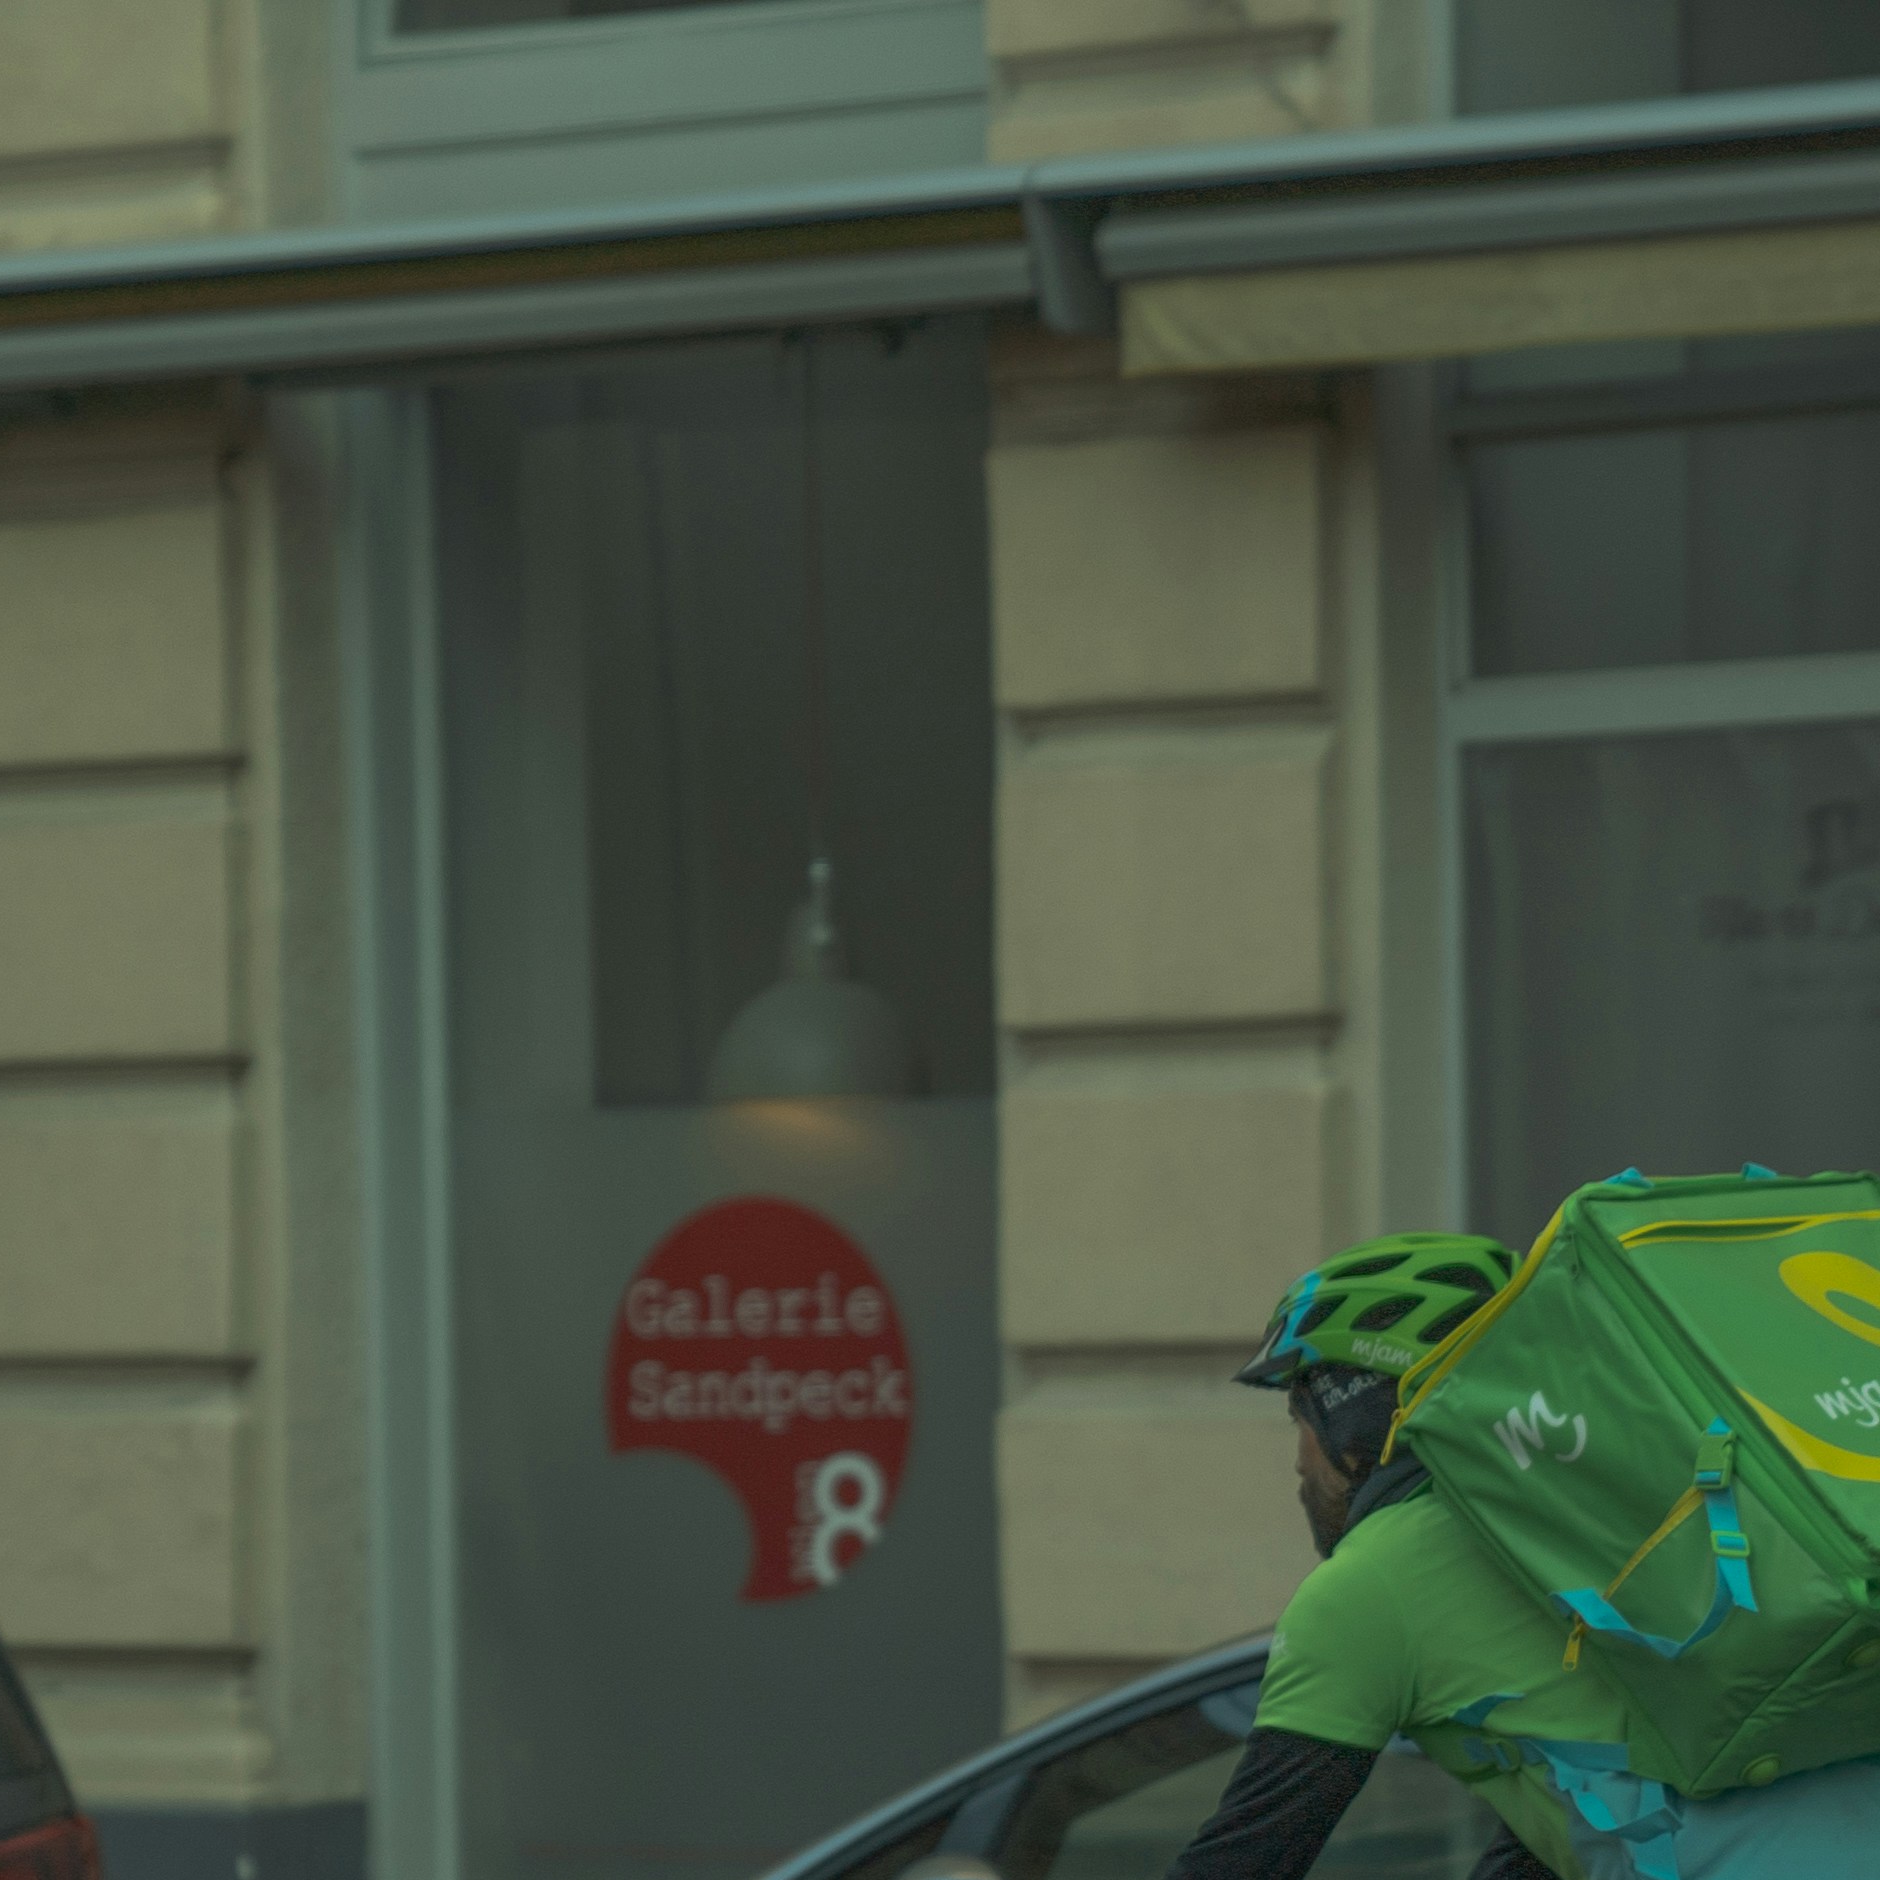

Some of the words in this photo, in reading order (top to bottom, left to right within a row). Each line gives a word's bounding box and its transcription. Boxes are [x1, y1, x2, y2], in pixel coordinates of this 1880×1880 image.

[625, 1273, 887, 1340] Galerie
[1351, 1336, 1413, 1367] mjam
[626, 1354, 912, 1435] Sandpeck
[811, 1450, 885, 1588] 8
